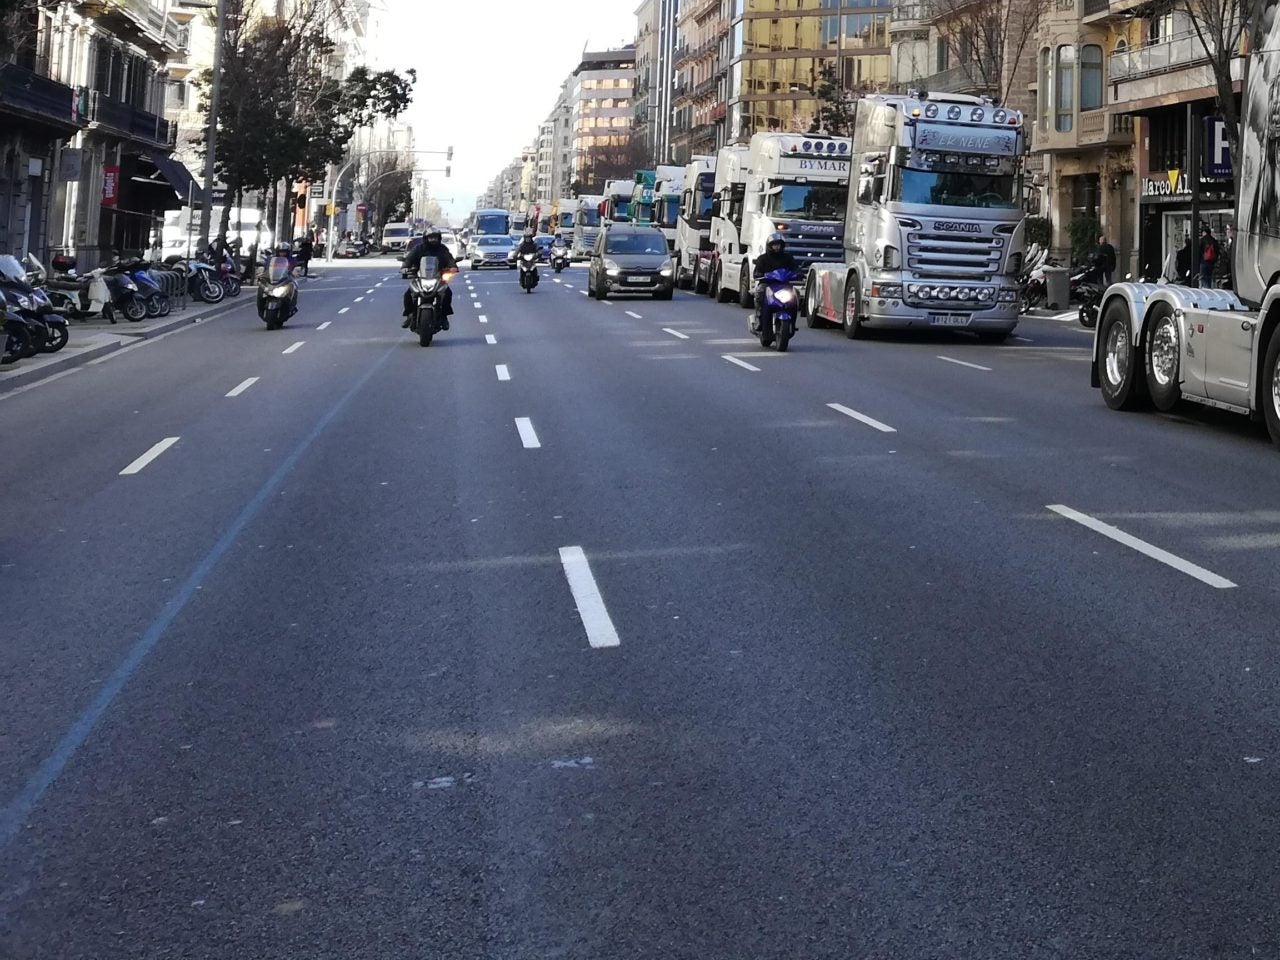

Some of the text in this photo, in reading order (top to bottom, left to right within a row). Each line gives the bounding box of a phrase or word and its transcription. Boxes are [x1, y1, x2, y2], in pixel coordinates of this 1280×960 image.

[799, 159, 847, 172] BYMAR
[1142, 178, 1171, 196] Marco
[800, 224, 835, 233] SCANIA
[933, 221, 982, 233] SCANIA
